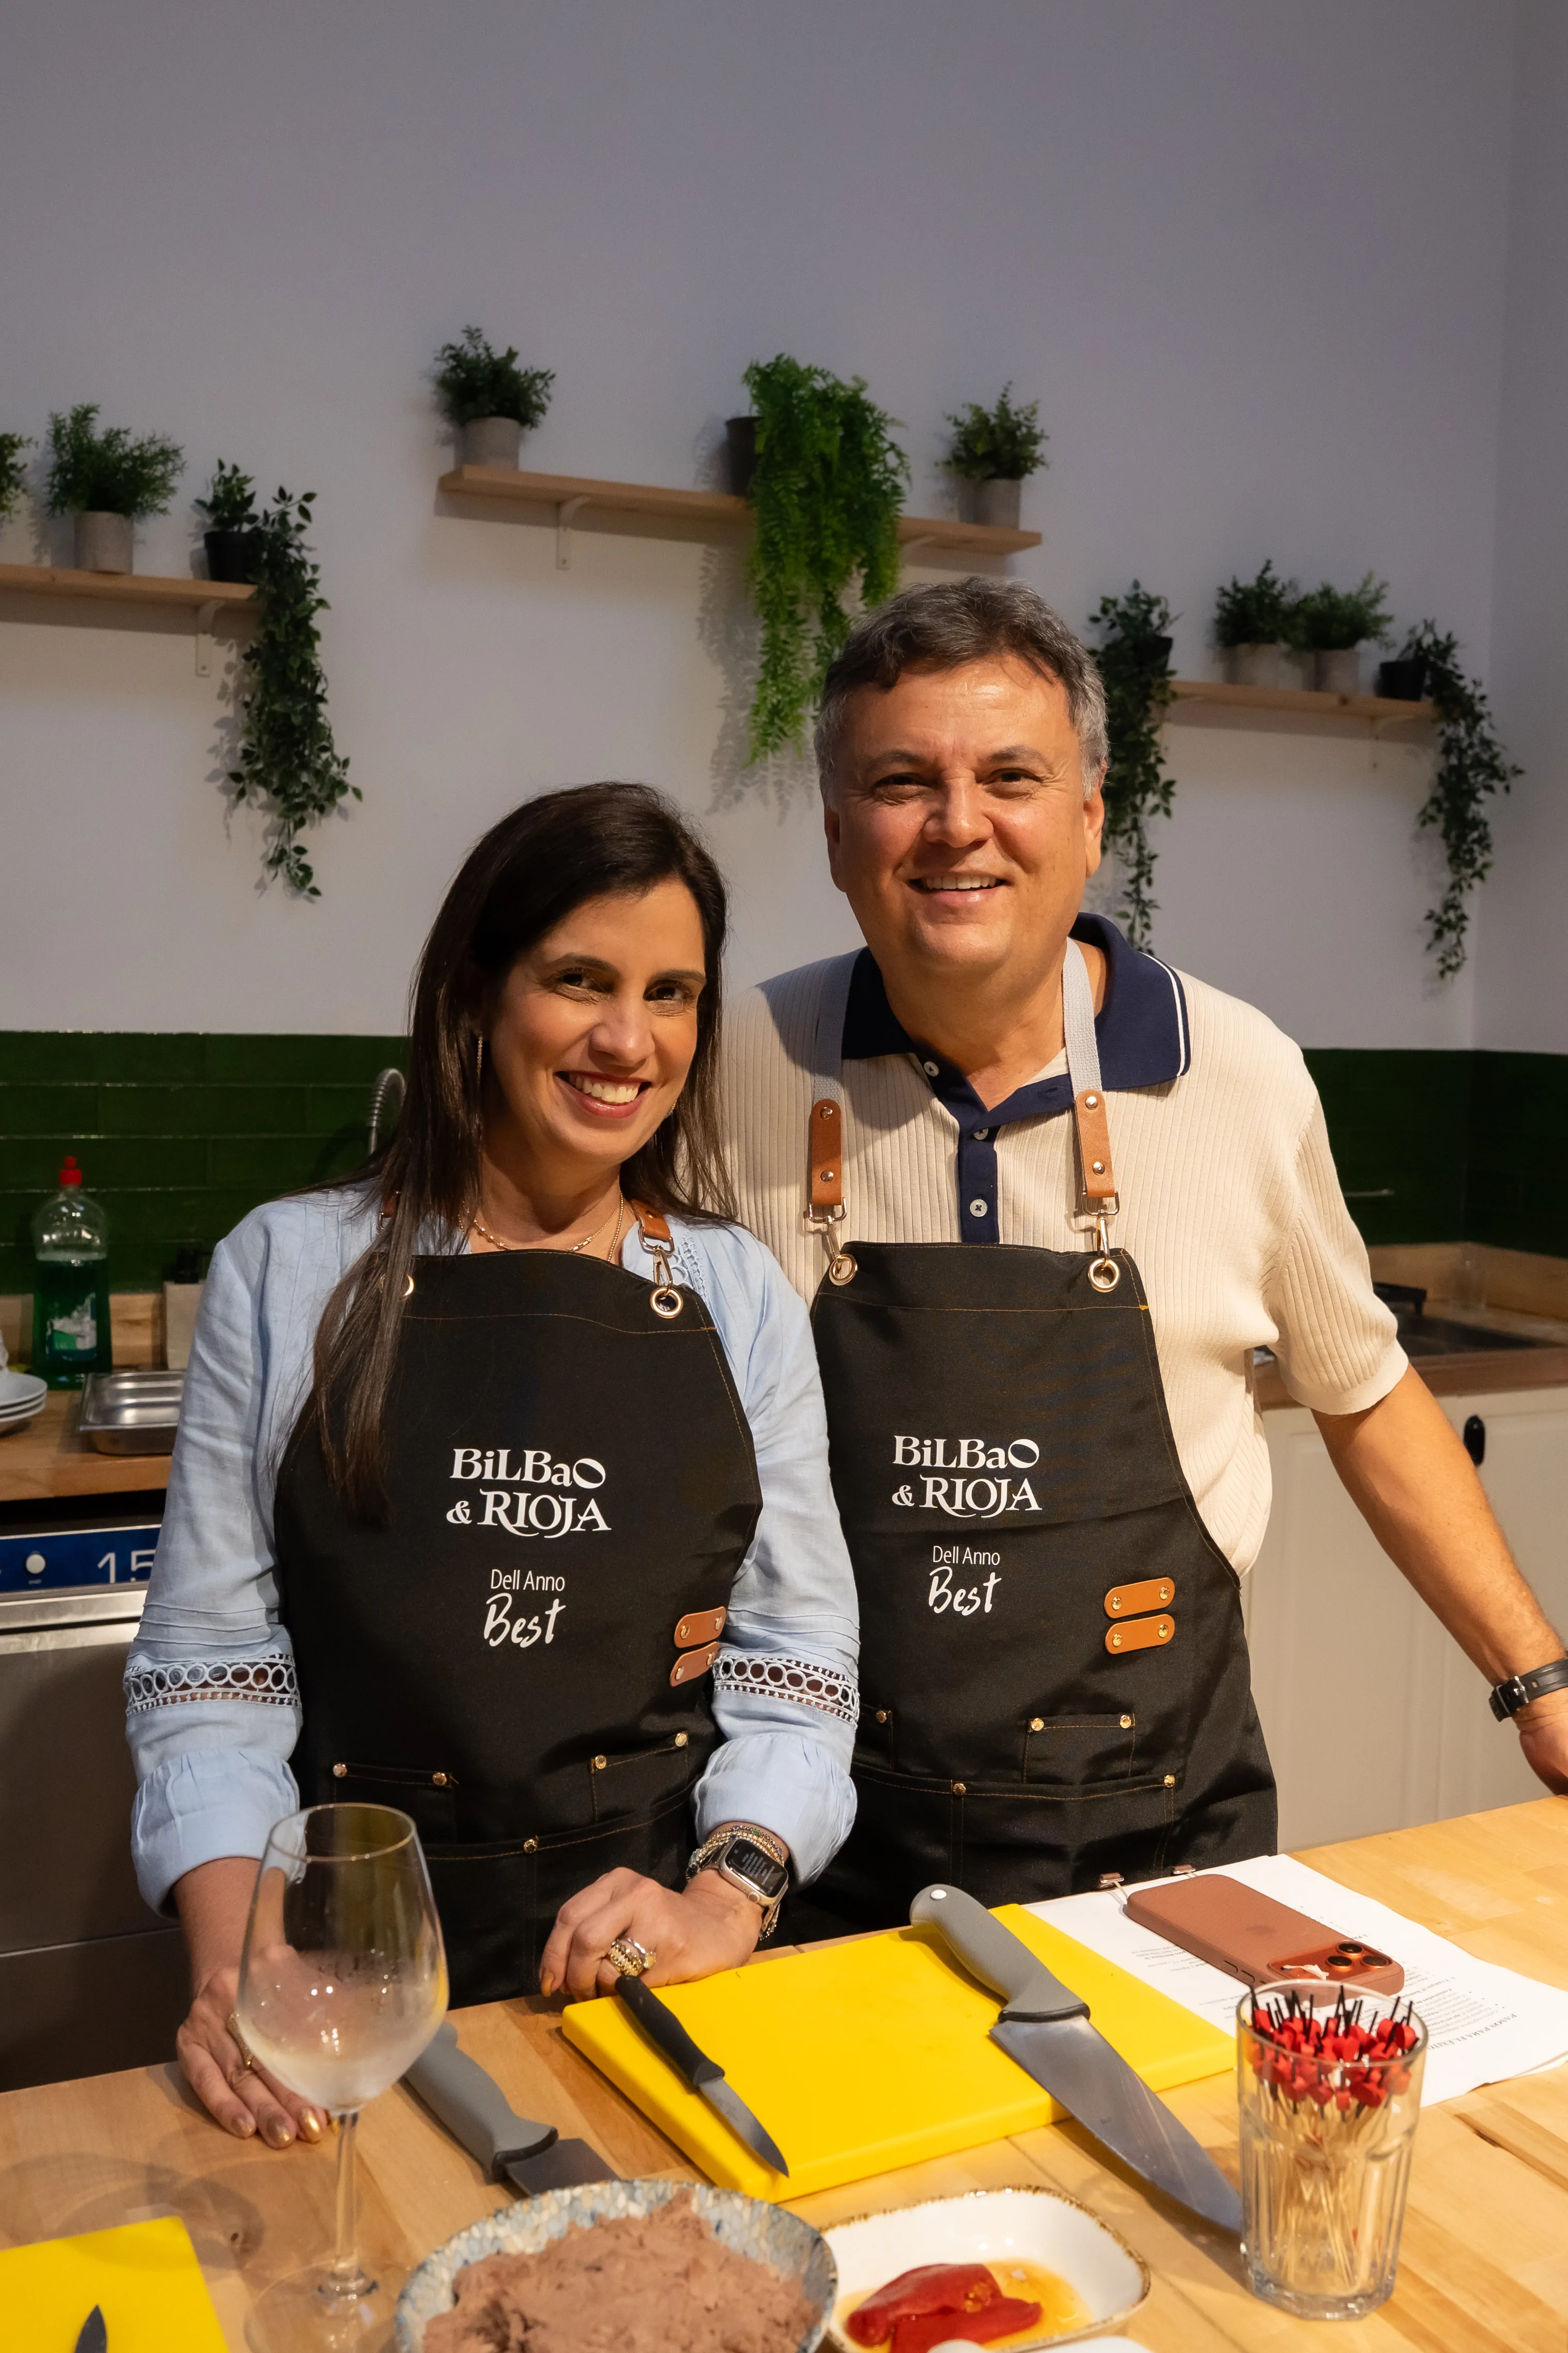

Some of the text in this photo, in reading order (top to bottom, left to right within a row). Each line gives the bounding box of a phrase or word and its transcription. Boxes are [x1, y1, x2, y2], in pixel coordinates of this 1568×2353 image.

[446, 1488, 612, 1538] & RIOJA
[892, 1474, 1043, 1518] & RIOJA
[933, 1545, 1000, 1566] Dell Anno
[491, 1568, 565, 1592] Dell Anno
[928, 1566, 1002, 1616] Best
[483, 1592, 566, 1648] Best
